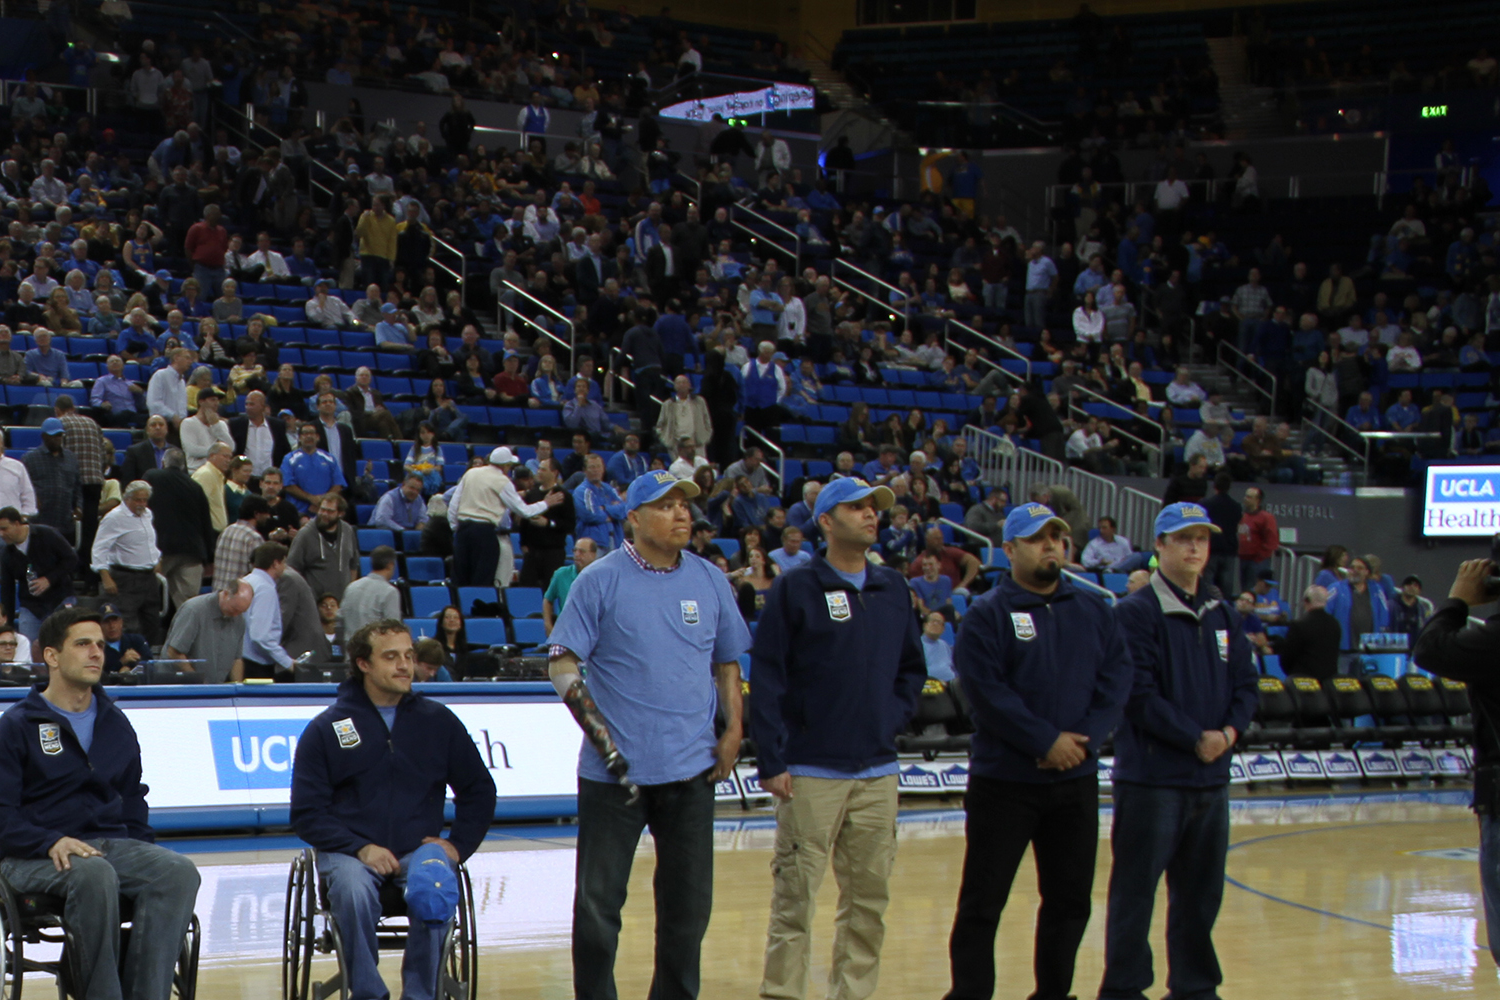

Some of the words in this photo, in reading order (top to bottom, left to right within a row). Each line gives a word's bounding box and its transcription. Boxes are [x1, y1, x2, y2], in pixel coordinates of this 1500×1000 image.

[1422, 105, 1447, 118] EXIT
[1440, 479, 1495, 497] UCLA
[1266, 504, 1336, 519] BASKETBALL
[1426, 508, 1500, 528] Health
